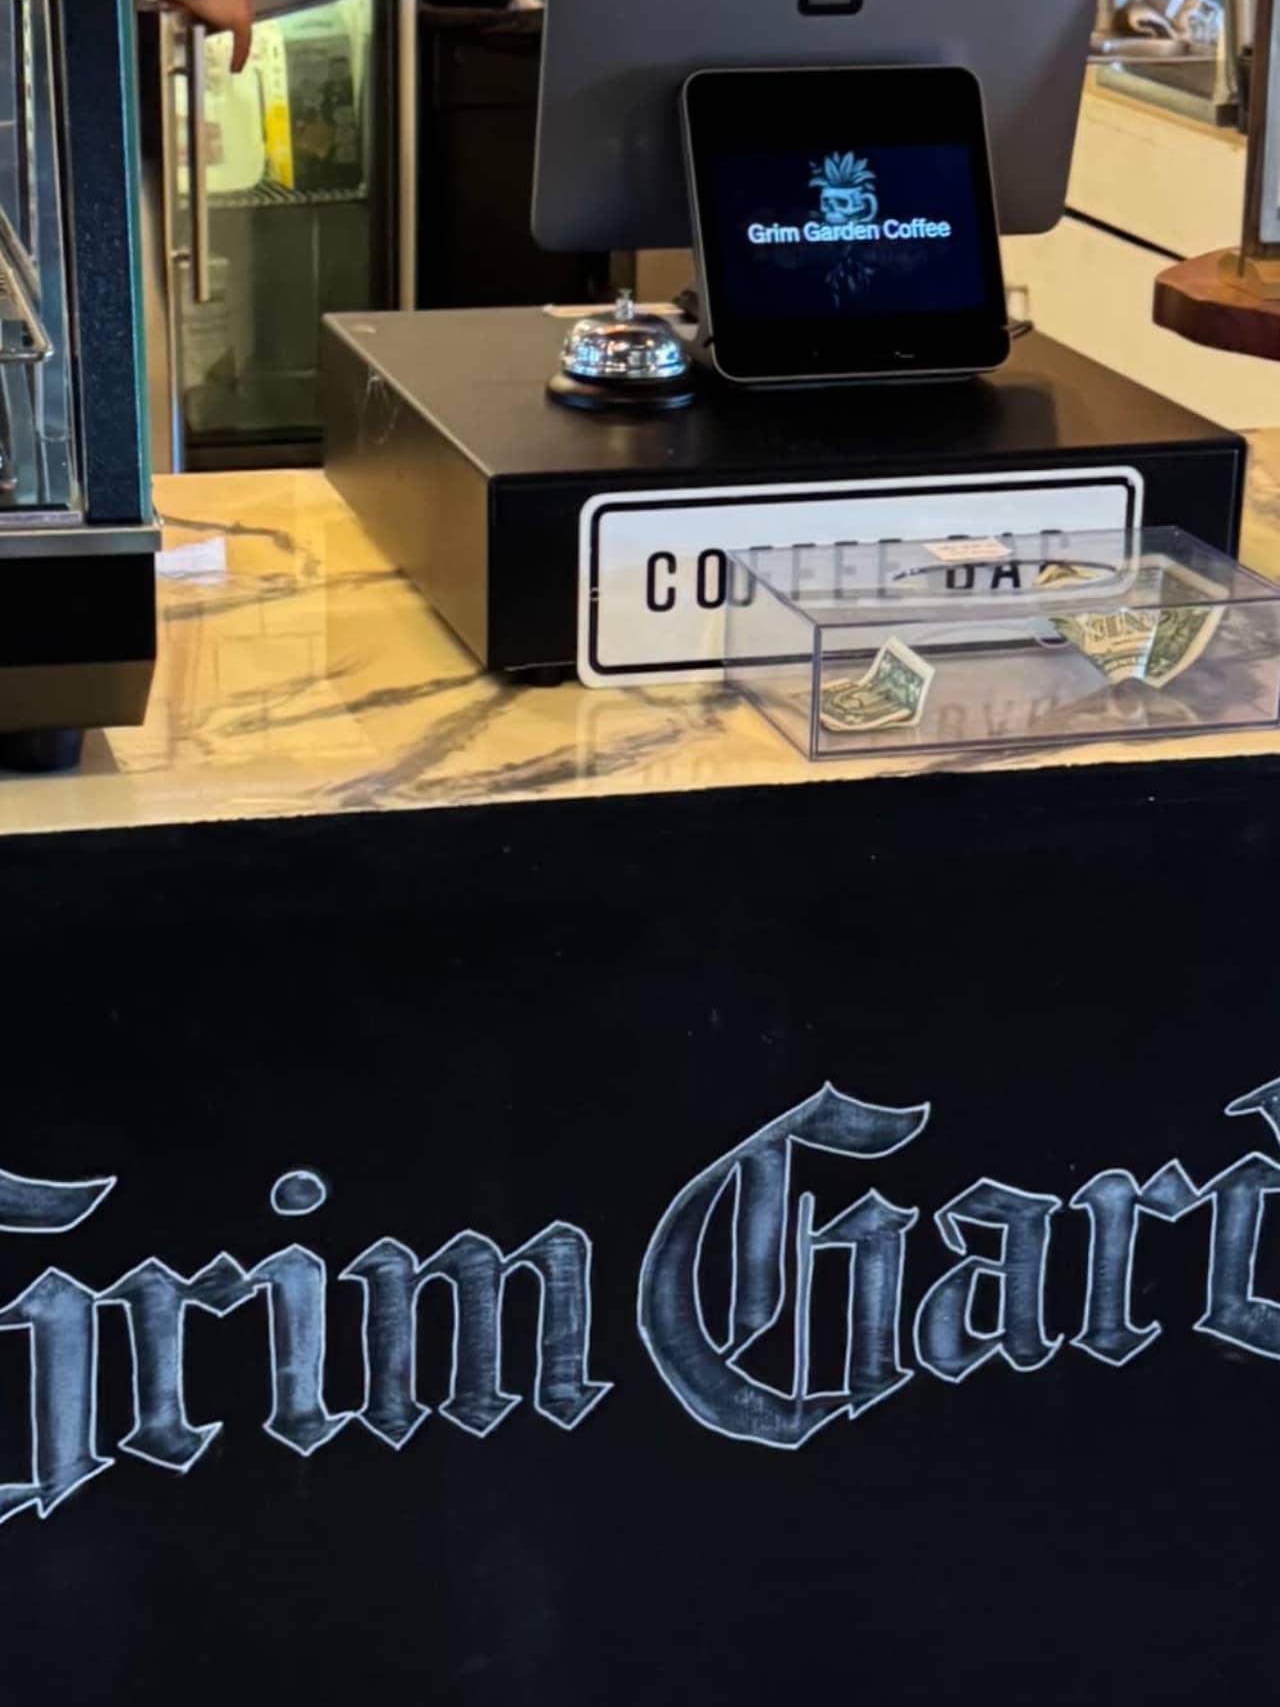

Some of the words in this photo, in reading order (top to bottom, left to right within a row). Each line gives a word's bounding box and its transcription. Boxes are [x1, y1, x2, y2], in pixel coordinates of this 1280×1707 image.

[748, 222, 800, 243] Grim
[804, 220, 880, 241] Garden
[884, 217, 950, 239] Coffee
[647, 535, 904, 613] COFFEE
